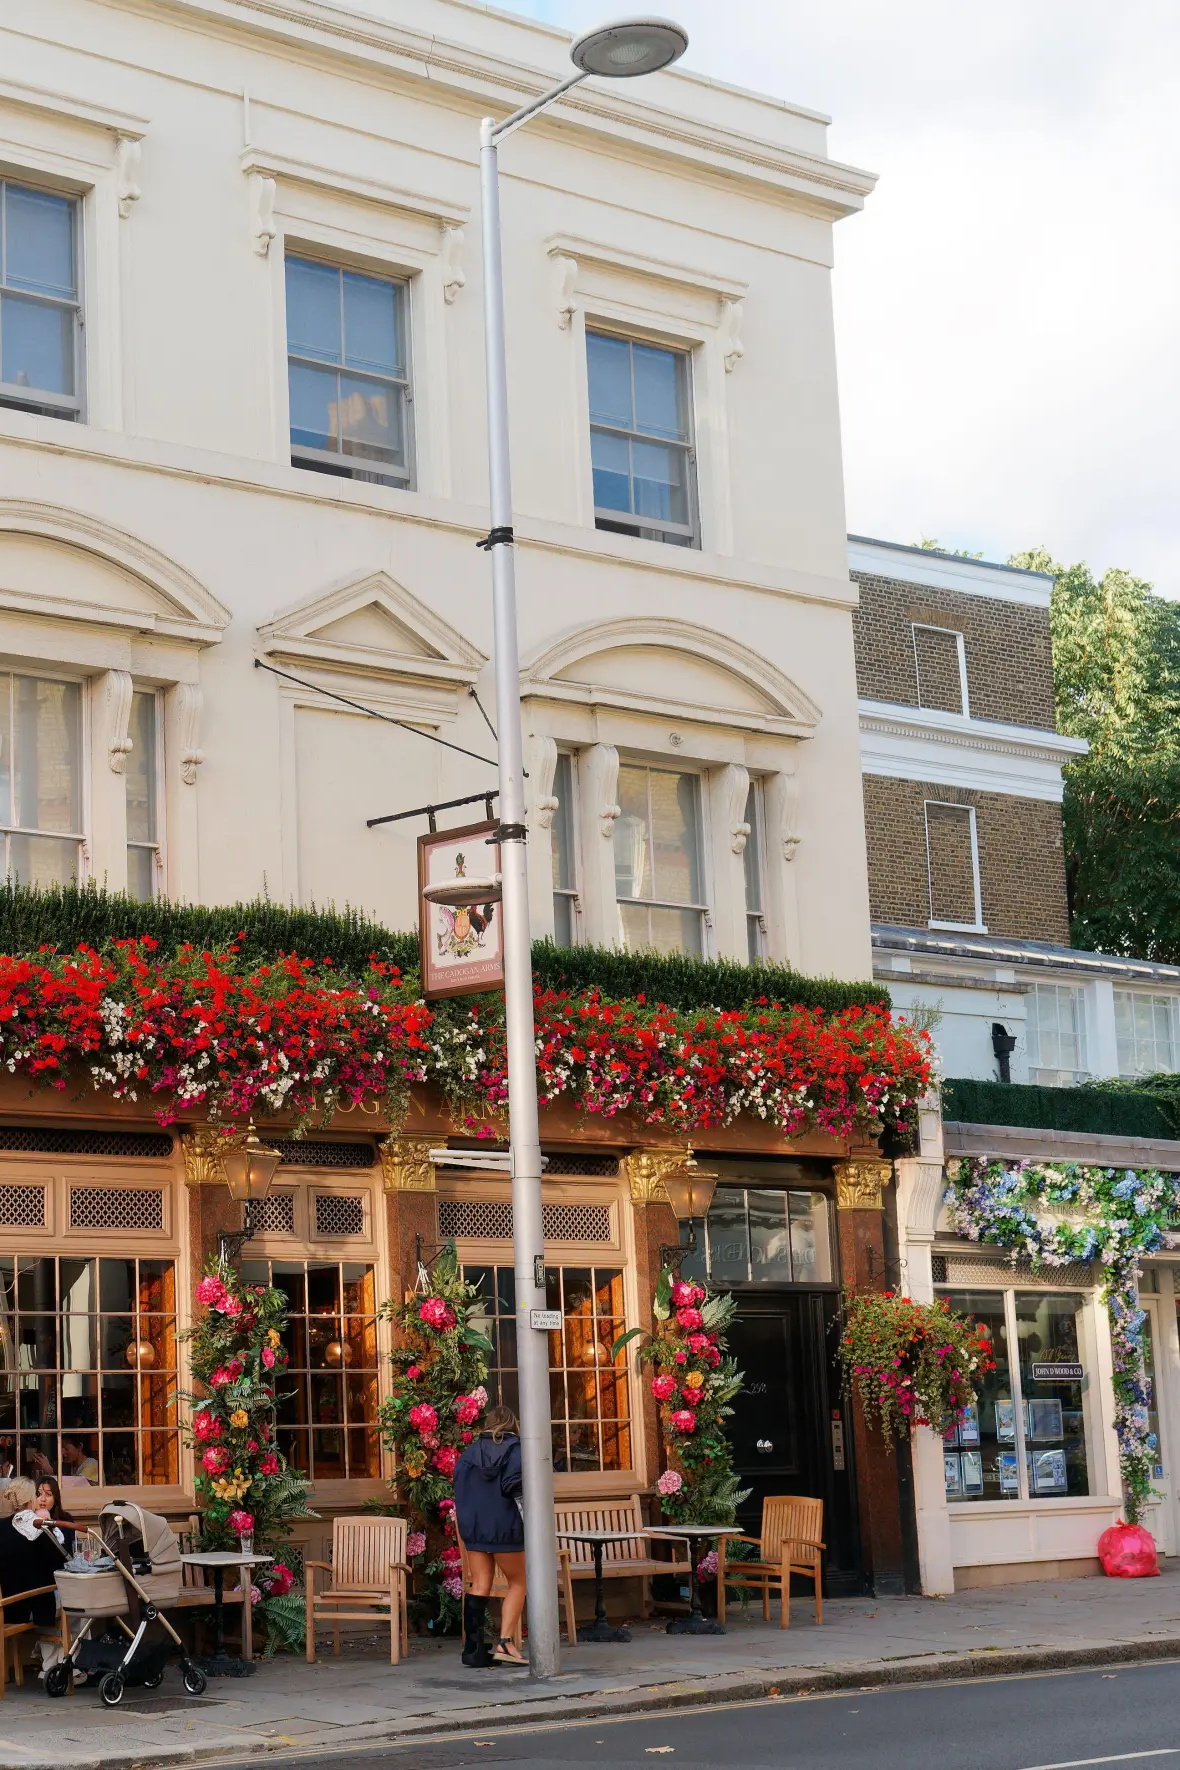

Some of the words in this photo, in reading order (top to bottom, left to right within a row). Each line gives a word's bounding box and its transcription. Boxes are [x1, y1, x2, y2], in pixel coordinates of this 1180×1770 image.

[430, 970, 445, 981] THE
[444, 966, 480, 979] CADOGAN
[480, 962, 501, 973] ARMS
[1035, 1367, 1050, 1376] JOHN
[1054, 1367, 1069, 1375] WOOD
